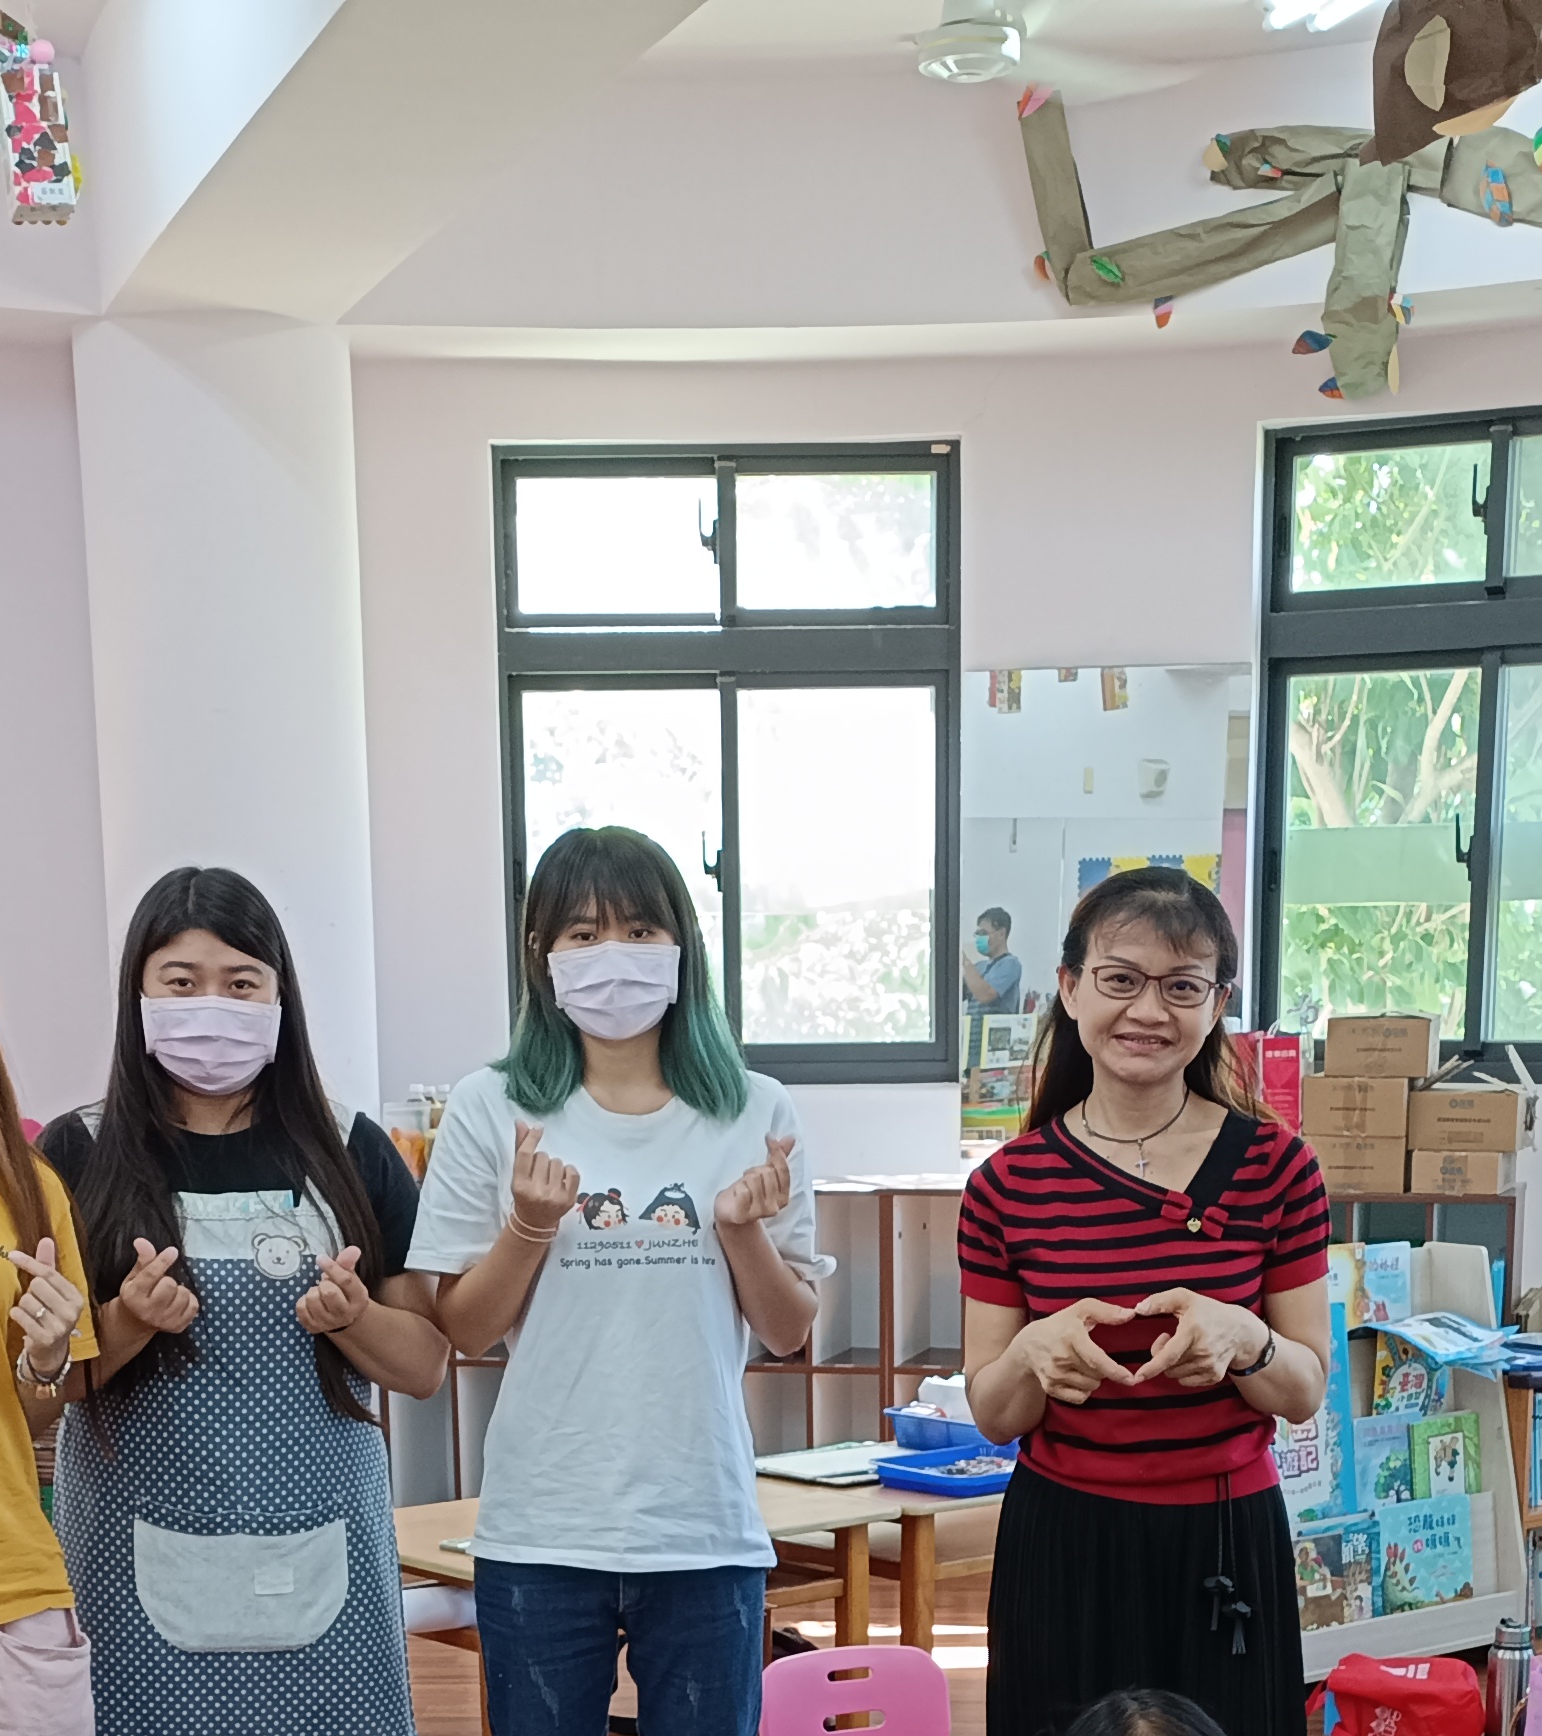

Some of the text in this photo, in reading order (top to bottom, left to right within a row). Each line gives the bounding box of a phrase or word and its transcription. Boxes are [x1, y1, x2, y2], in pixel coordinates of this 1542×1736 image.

[577, 1241, 632, 1253] 11290511
[560, 1257, 591, 1270] Spring
[594, 1257, 612, 1267] has
[691, 1255, 699, 1265] is
[1271, 1444, 1319, 1479] 遊記
